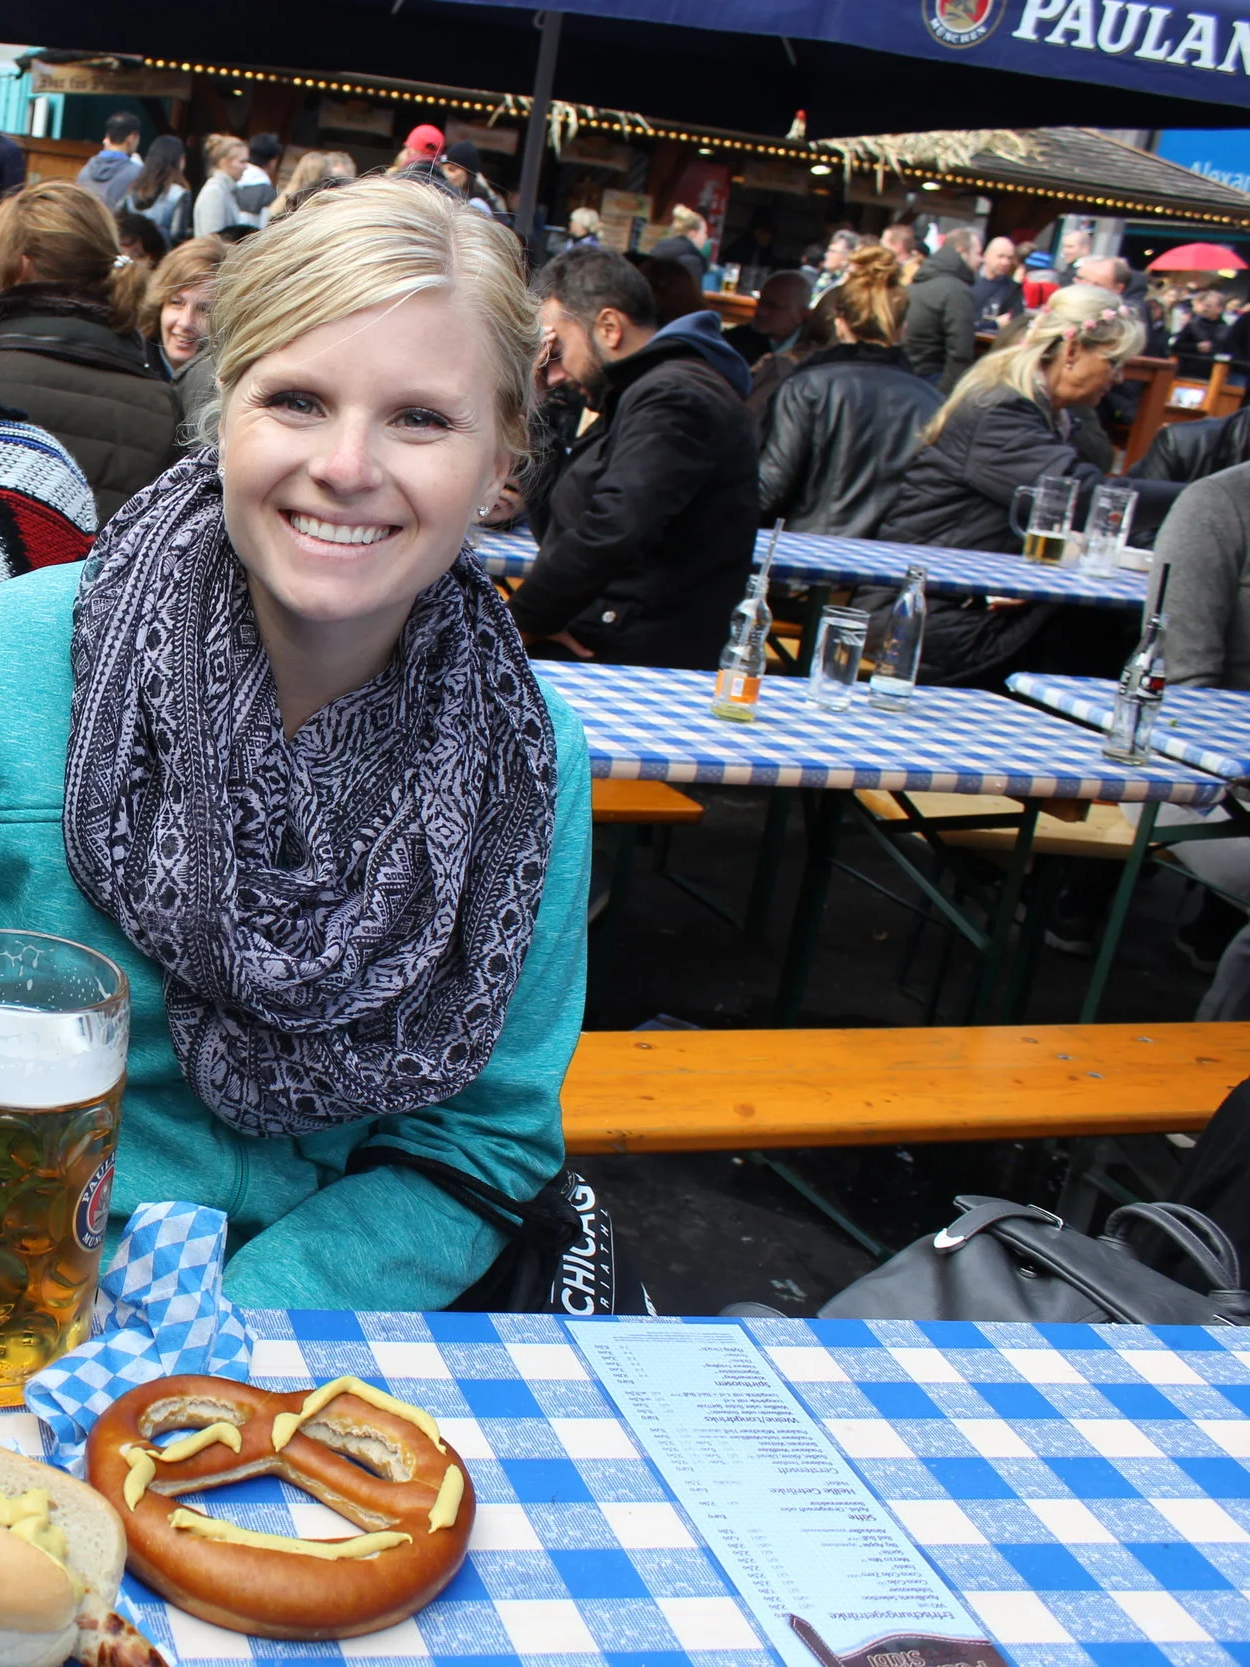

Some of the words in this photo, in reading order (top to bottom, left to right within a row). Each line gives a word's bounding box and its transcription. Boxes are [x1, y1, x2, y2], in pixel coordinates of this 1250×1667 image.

[930, 17, 988, 44] MÜNCHEN
[704, 1415, 799, 1423] Weine/Longdrinks
[769, 1487, 822, 1495] Getränke
[847, 1513, 877, 1521] Säfte
[827, 1610, 955, 1620] Erfrischungsgetränke
